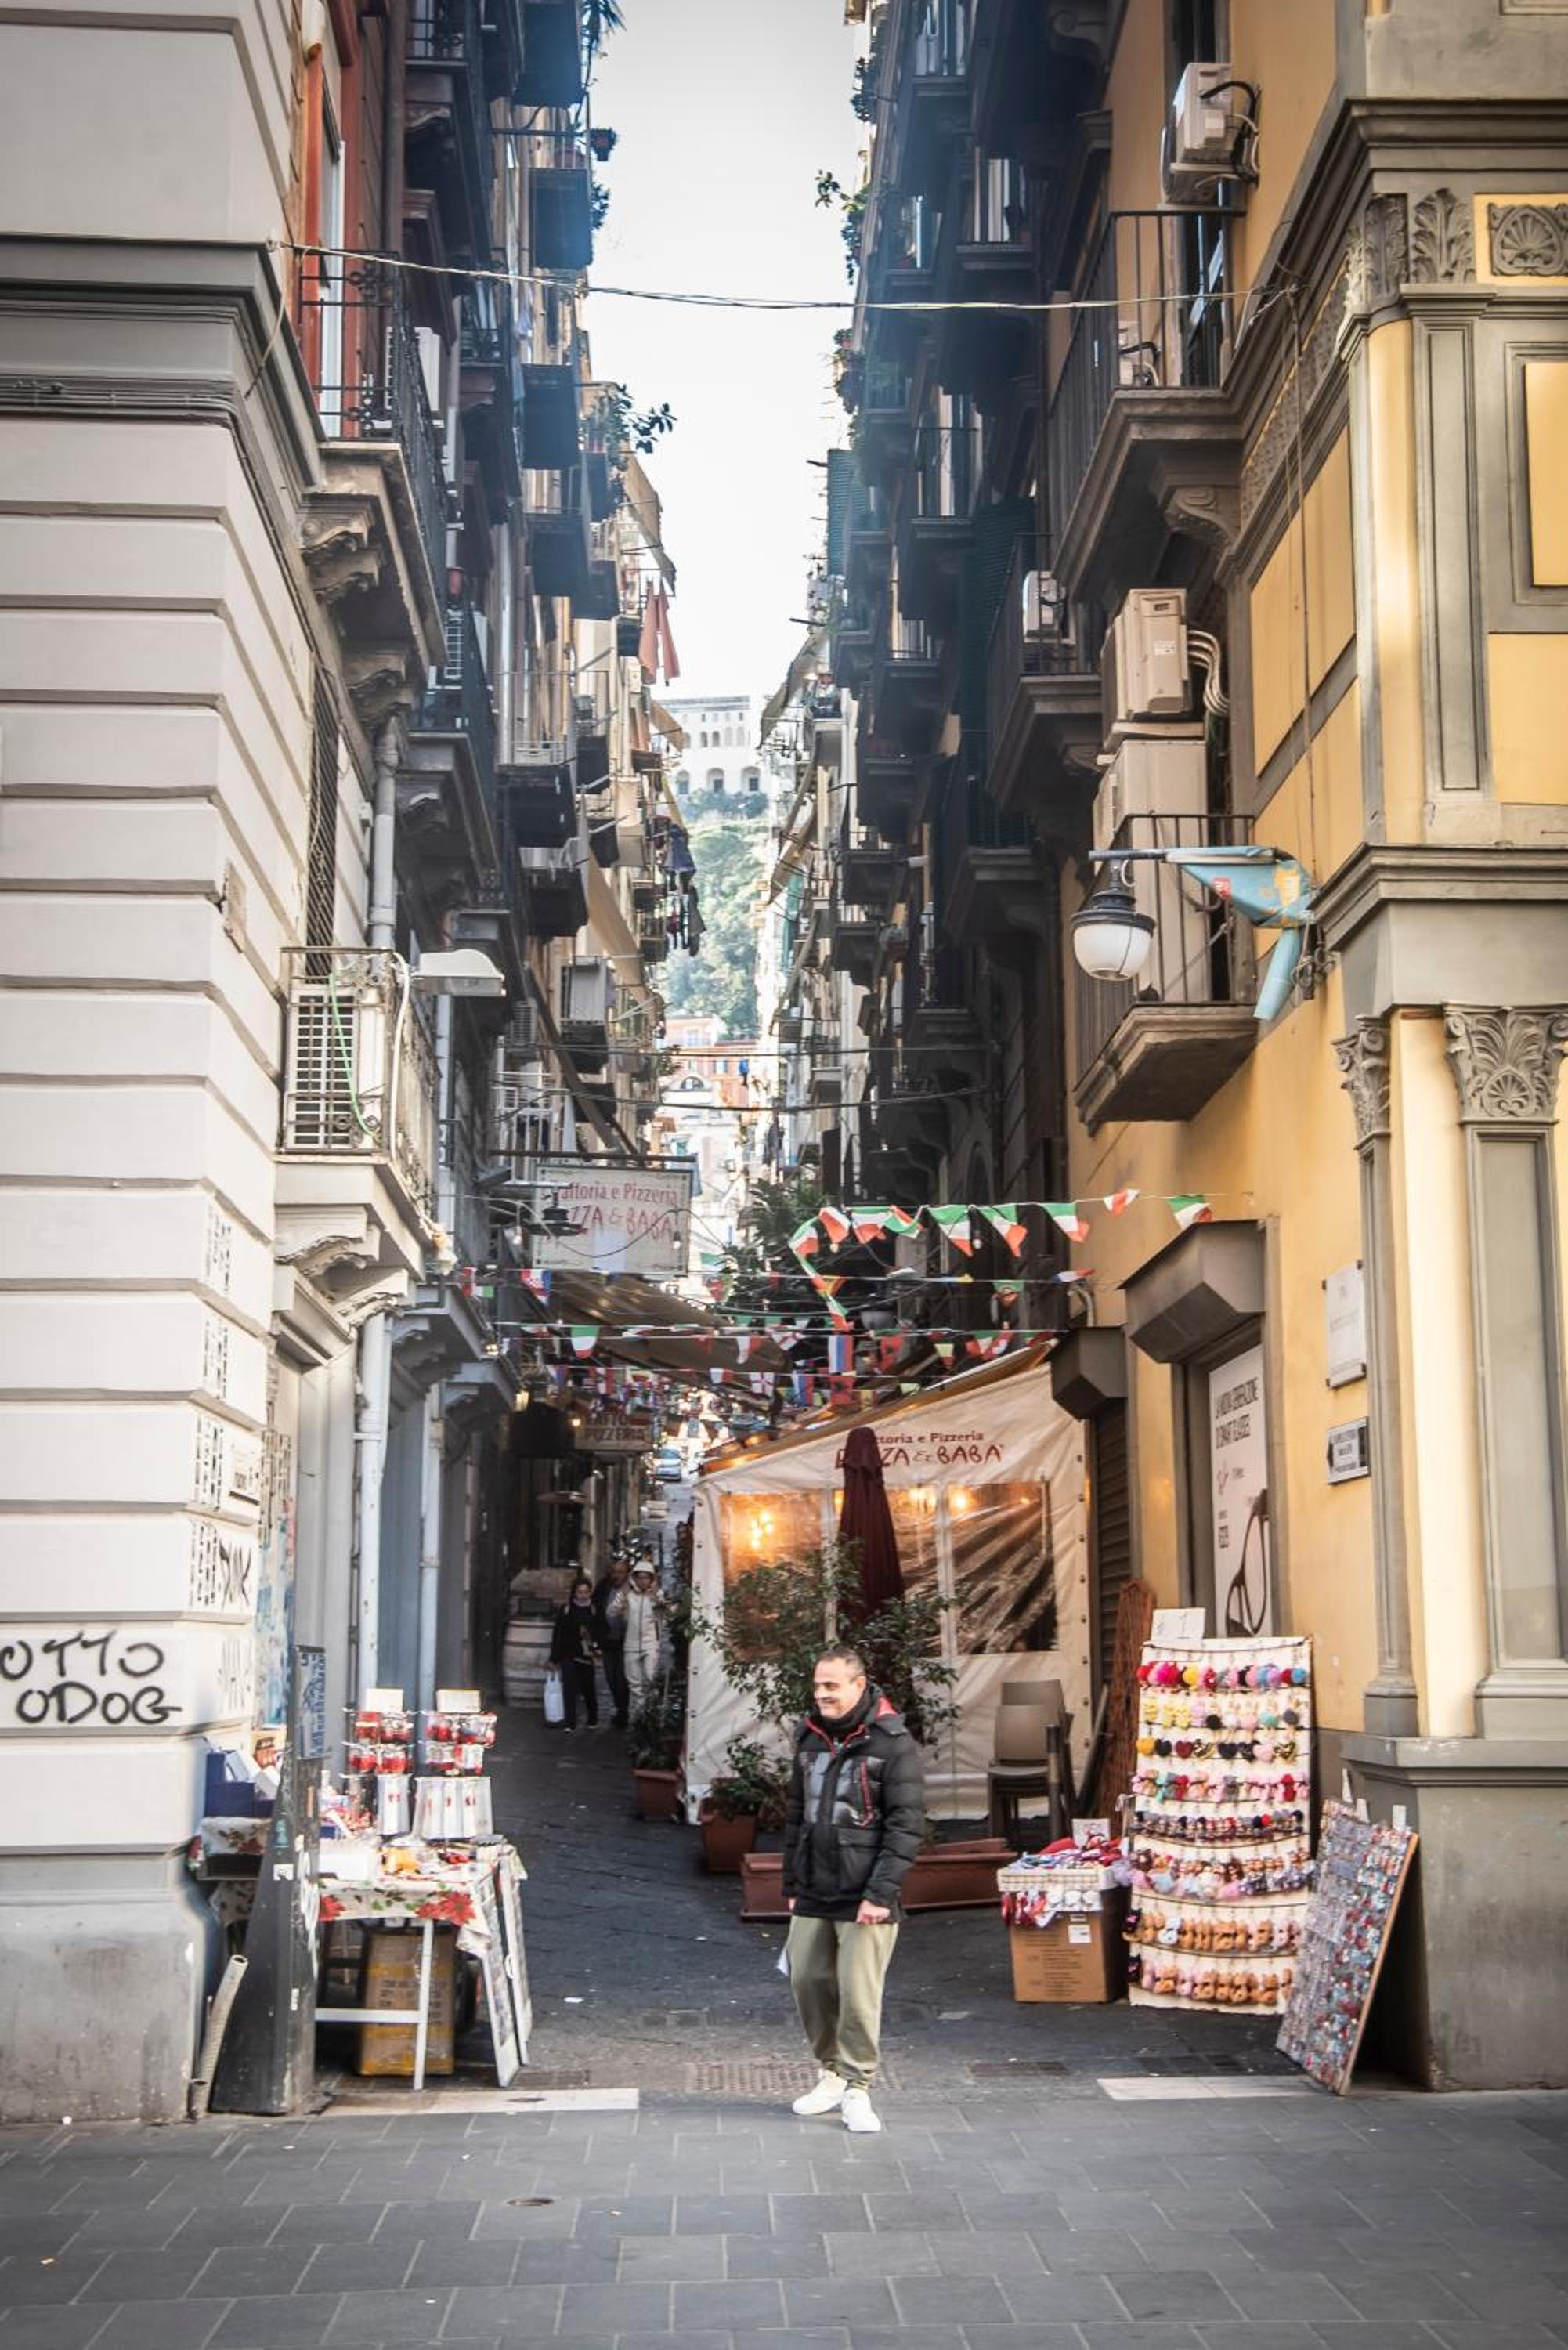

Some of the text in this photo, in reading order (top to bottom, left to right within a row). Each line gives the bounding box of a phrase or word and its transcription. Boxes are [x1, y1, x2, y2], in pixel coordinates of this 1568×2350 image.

[611, 1187, 620, 1199] e
[623, 1182, 678, 1205] Pizzeria
[930, 1430, 984, 1442] Pizzeria
